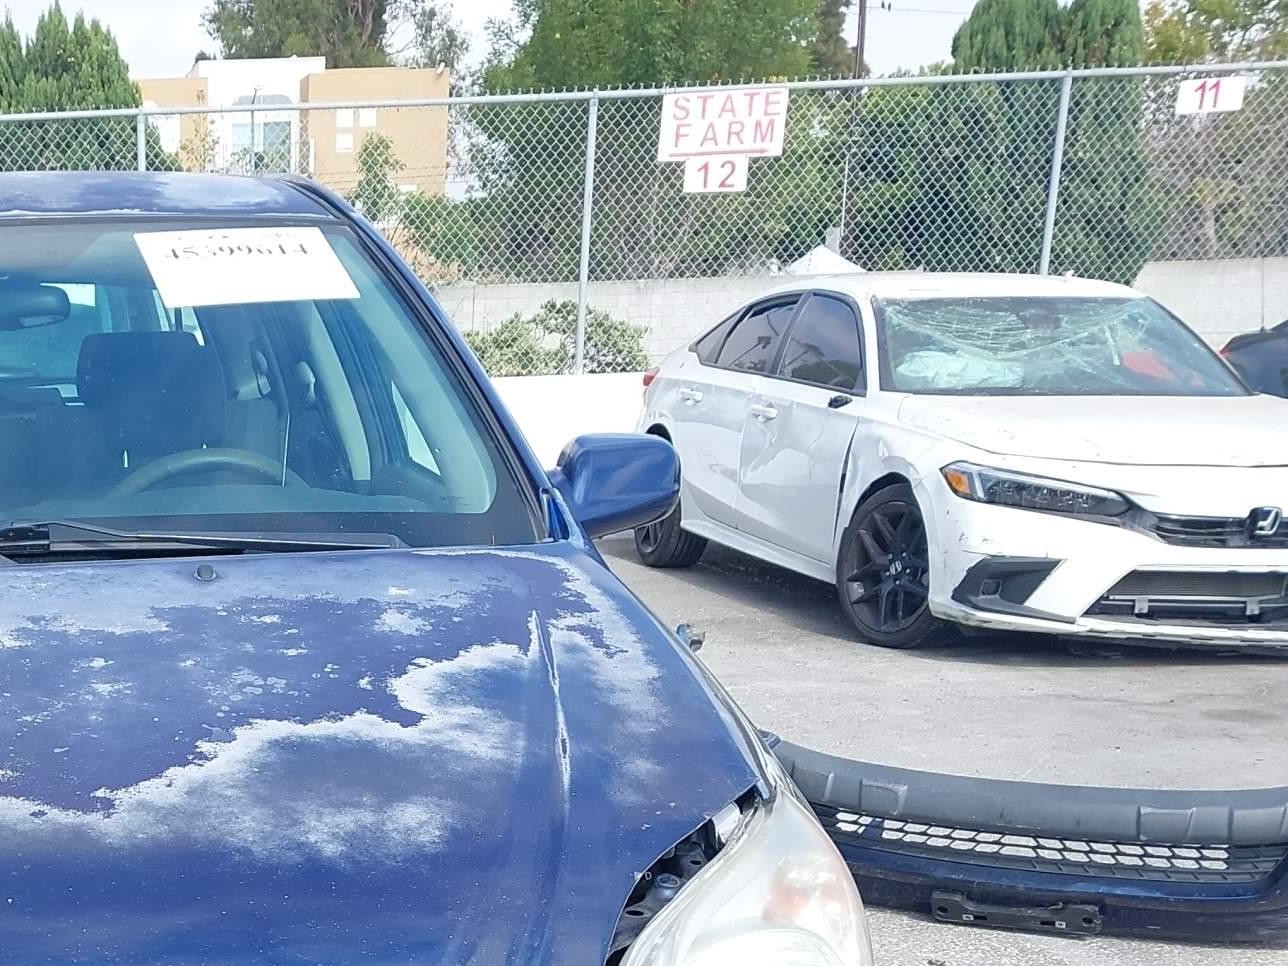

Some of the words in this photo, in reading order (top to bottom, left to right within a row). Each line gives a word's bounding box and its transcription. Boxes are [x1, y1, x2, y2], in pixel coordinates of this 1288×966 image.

[672, 91, 783, 121] STATE
[1193, 79, 1221, 110] 11
[674, 118, 775, 148] FARM
[696, 160, 737, 189] 12
